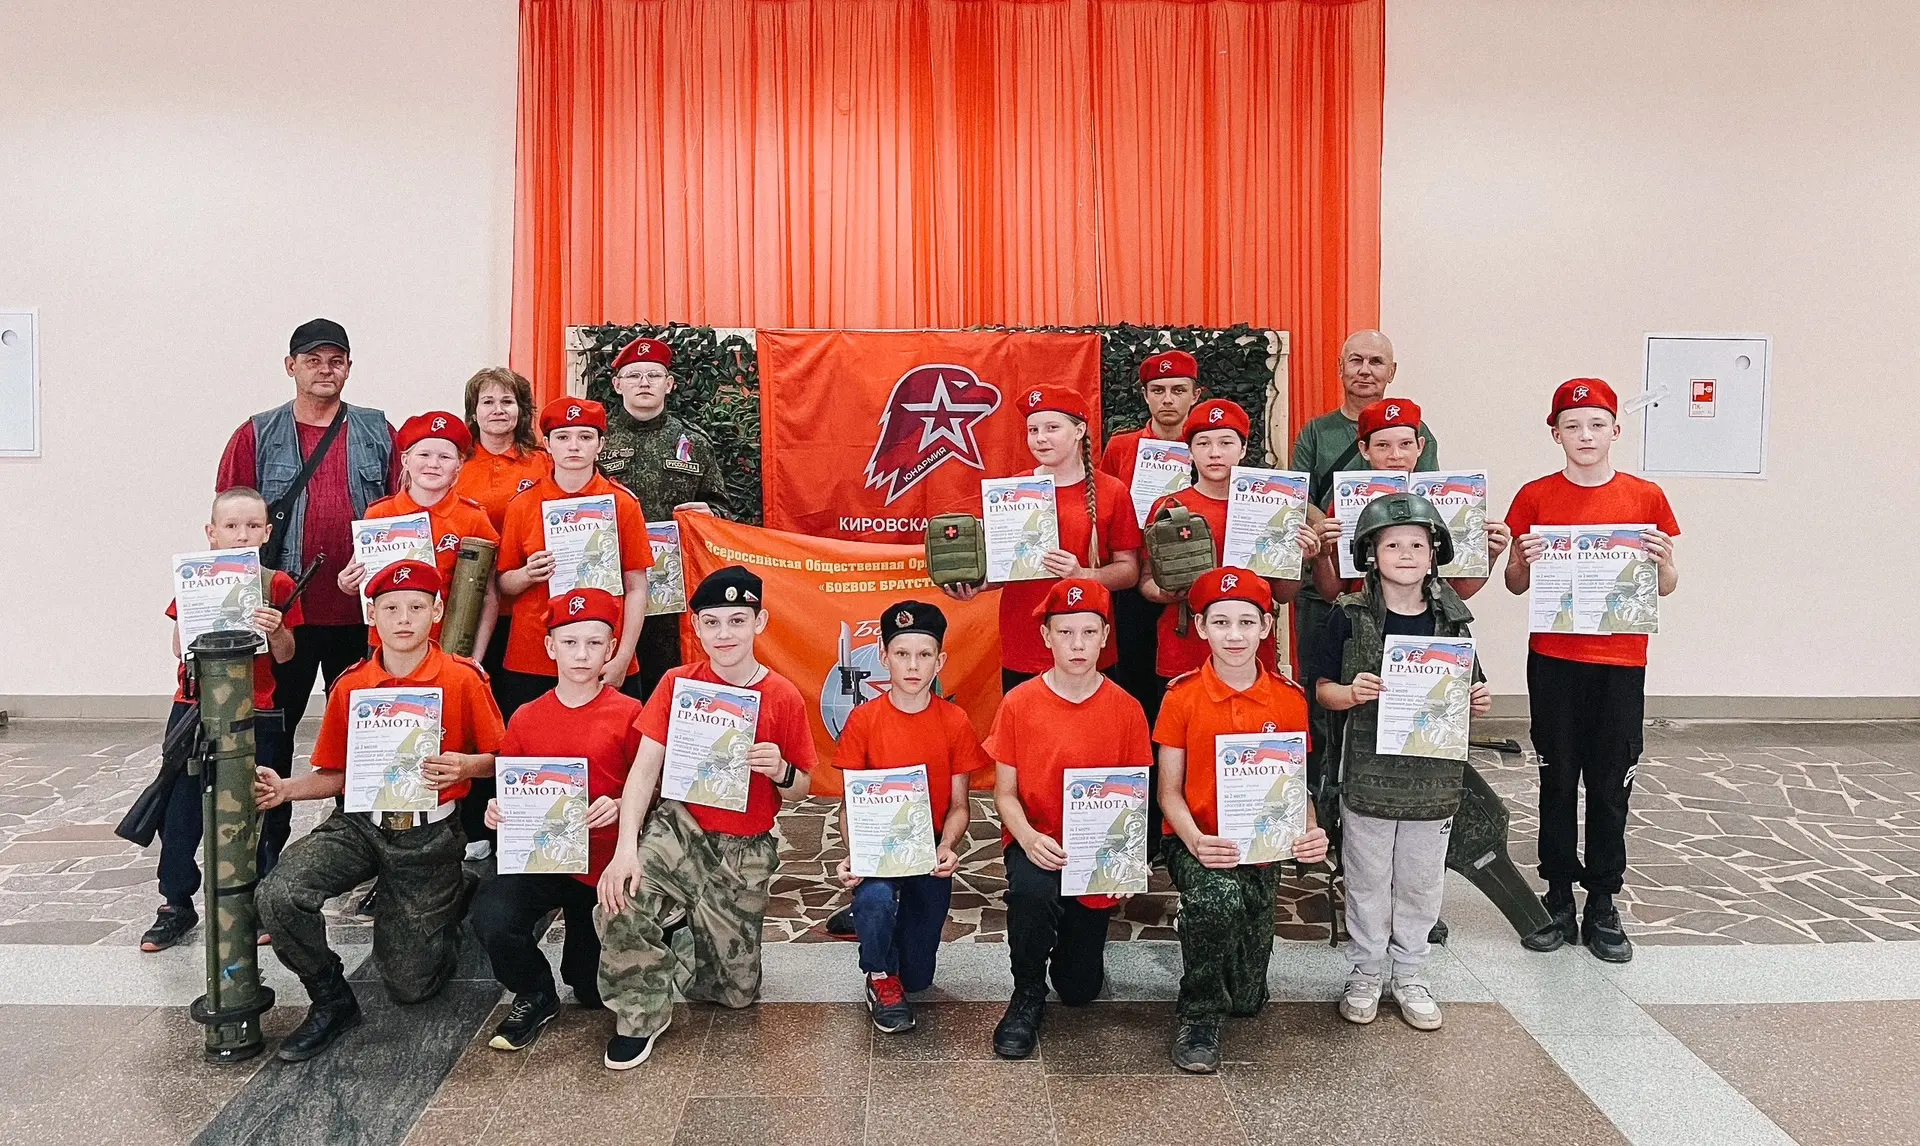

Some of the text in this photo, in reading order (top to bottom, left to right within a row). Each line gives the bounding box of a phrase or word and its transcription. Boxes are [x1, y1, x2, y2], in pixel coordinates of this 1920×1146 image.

[903, 447, 947, 482] ЮНАРМИЯ
[1140, 462, 1184, 472] ГРАМОТА
[1235, 494, 1288, 505] ГРАМОТА
[990, 502, 1039, 512] ГРАМОТА
[550, 523, 600, 535] ГРАМОТА
[839, 517, 928, 532] КИРОВСКА
[362, 542, 415, 554] ГРАМОТА
[704, 539, 802, 569] Всероссийская
[805, 559, 904, 573] Общественная
[182, 576, 241, 589] ГРАМОТА
[818, 582, 876, 593] «БОЕВОЕ
[1389, 665, 1451, 674] ГРАМОТА
[356, 719, 420, 729] ГРАМОТА
[678, 710, 736, 728] ГРАМОТА
[1224, 766, 1286, 776] ГРАМОТА
[504, 787, 566, 795] ГРАМОТА
[852, 795, 909, 804] ГРАМОТА
[1071, 800, 1128, 810] ГРАМОТА
